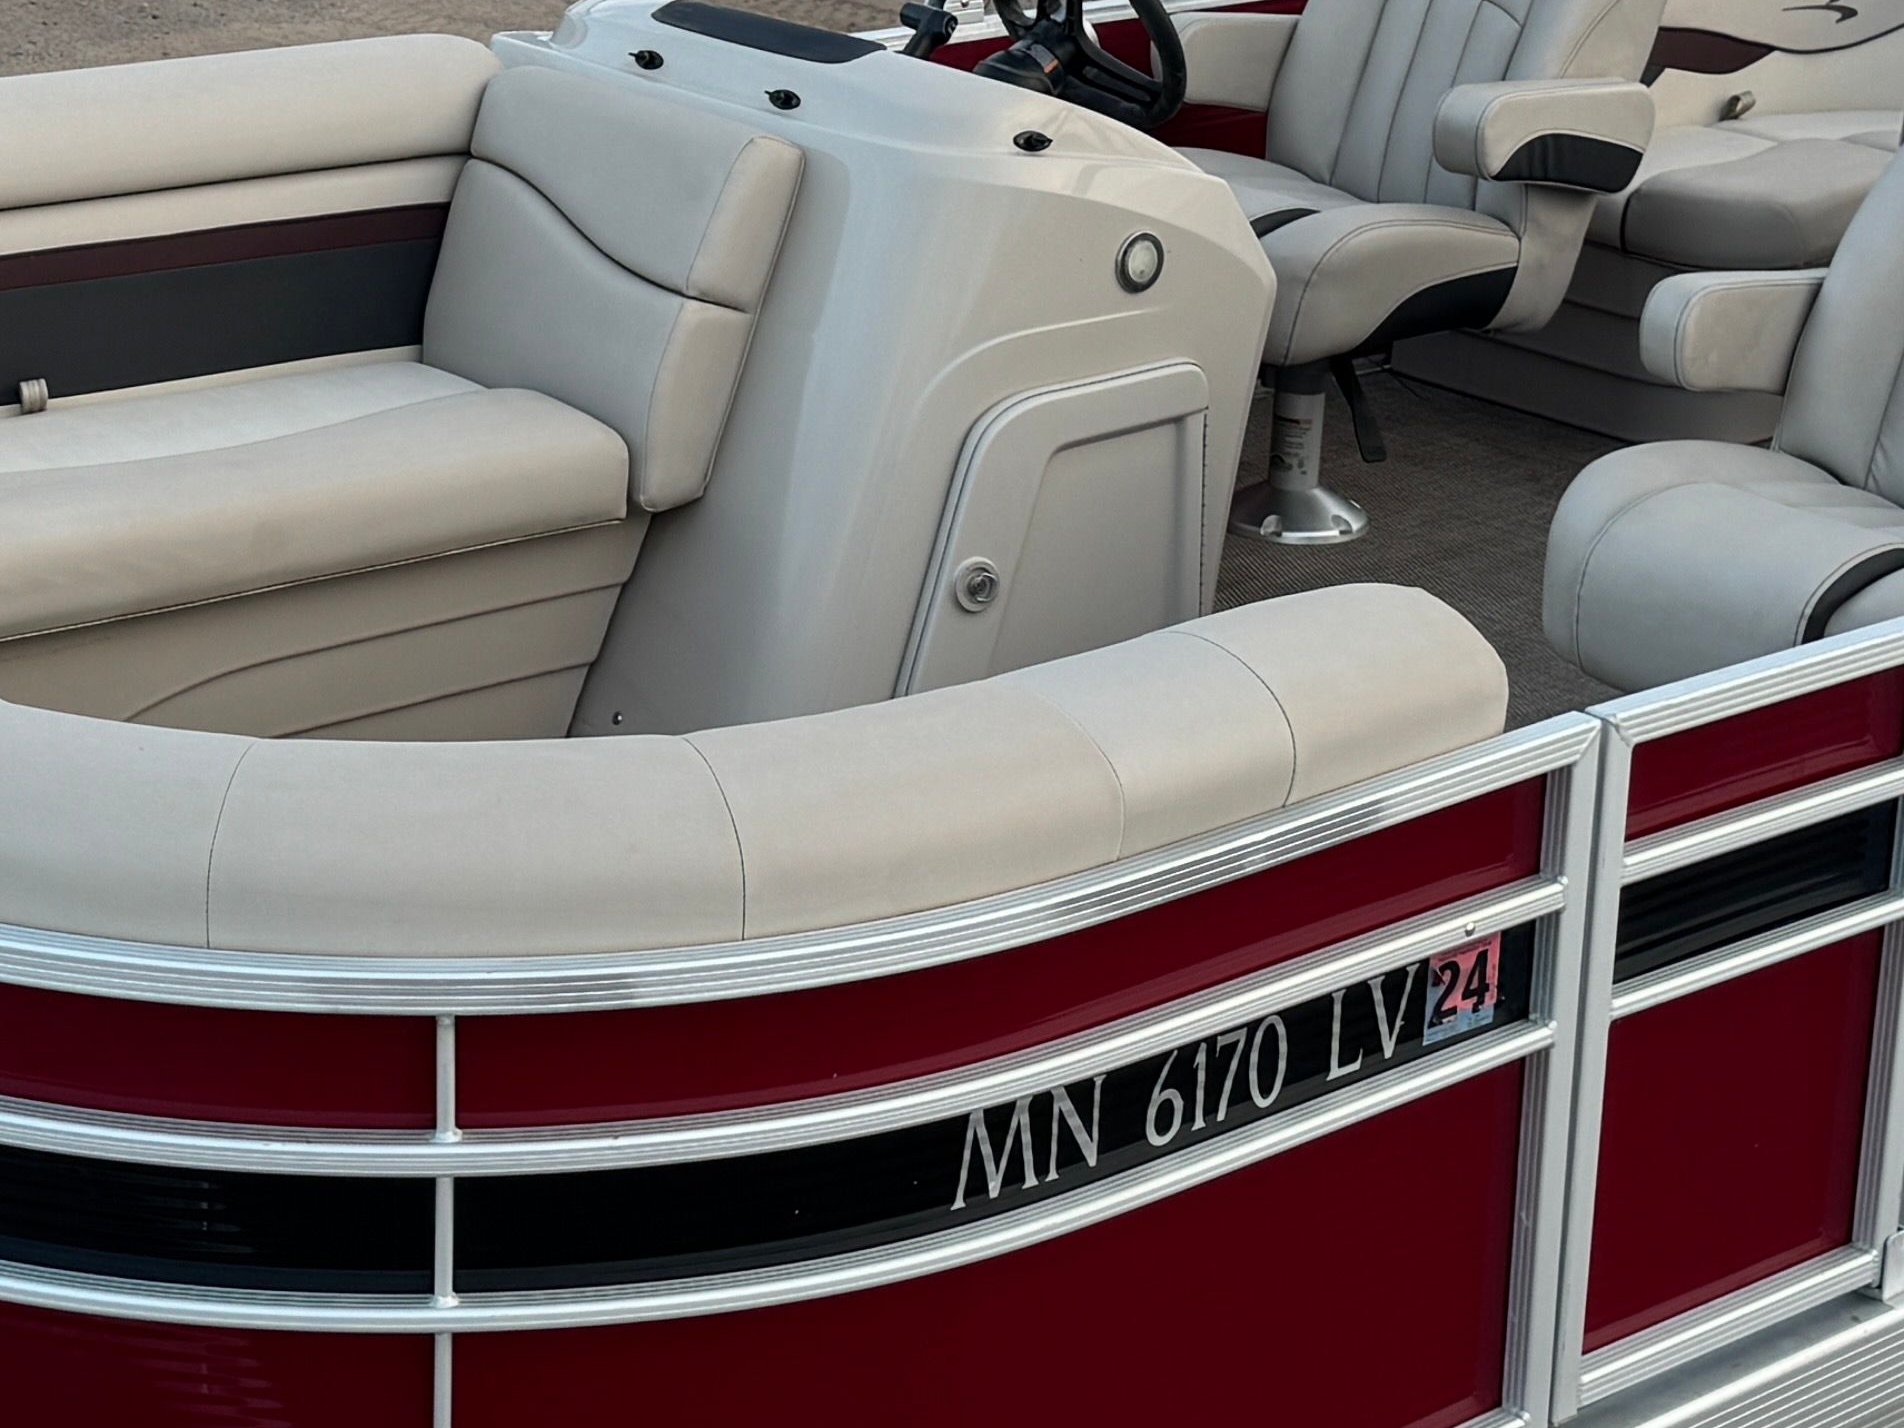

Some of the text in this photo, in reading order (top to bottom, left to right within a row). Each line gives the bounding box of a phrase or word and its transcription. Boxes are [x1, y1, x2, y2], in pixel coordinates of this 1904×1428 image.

[1427, 948, 1490, 1030] 24
[951, 963, 1421, 1210] MN 6170 LV
